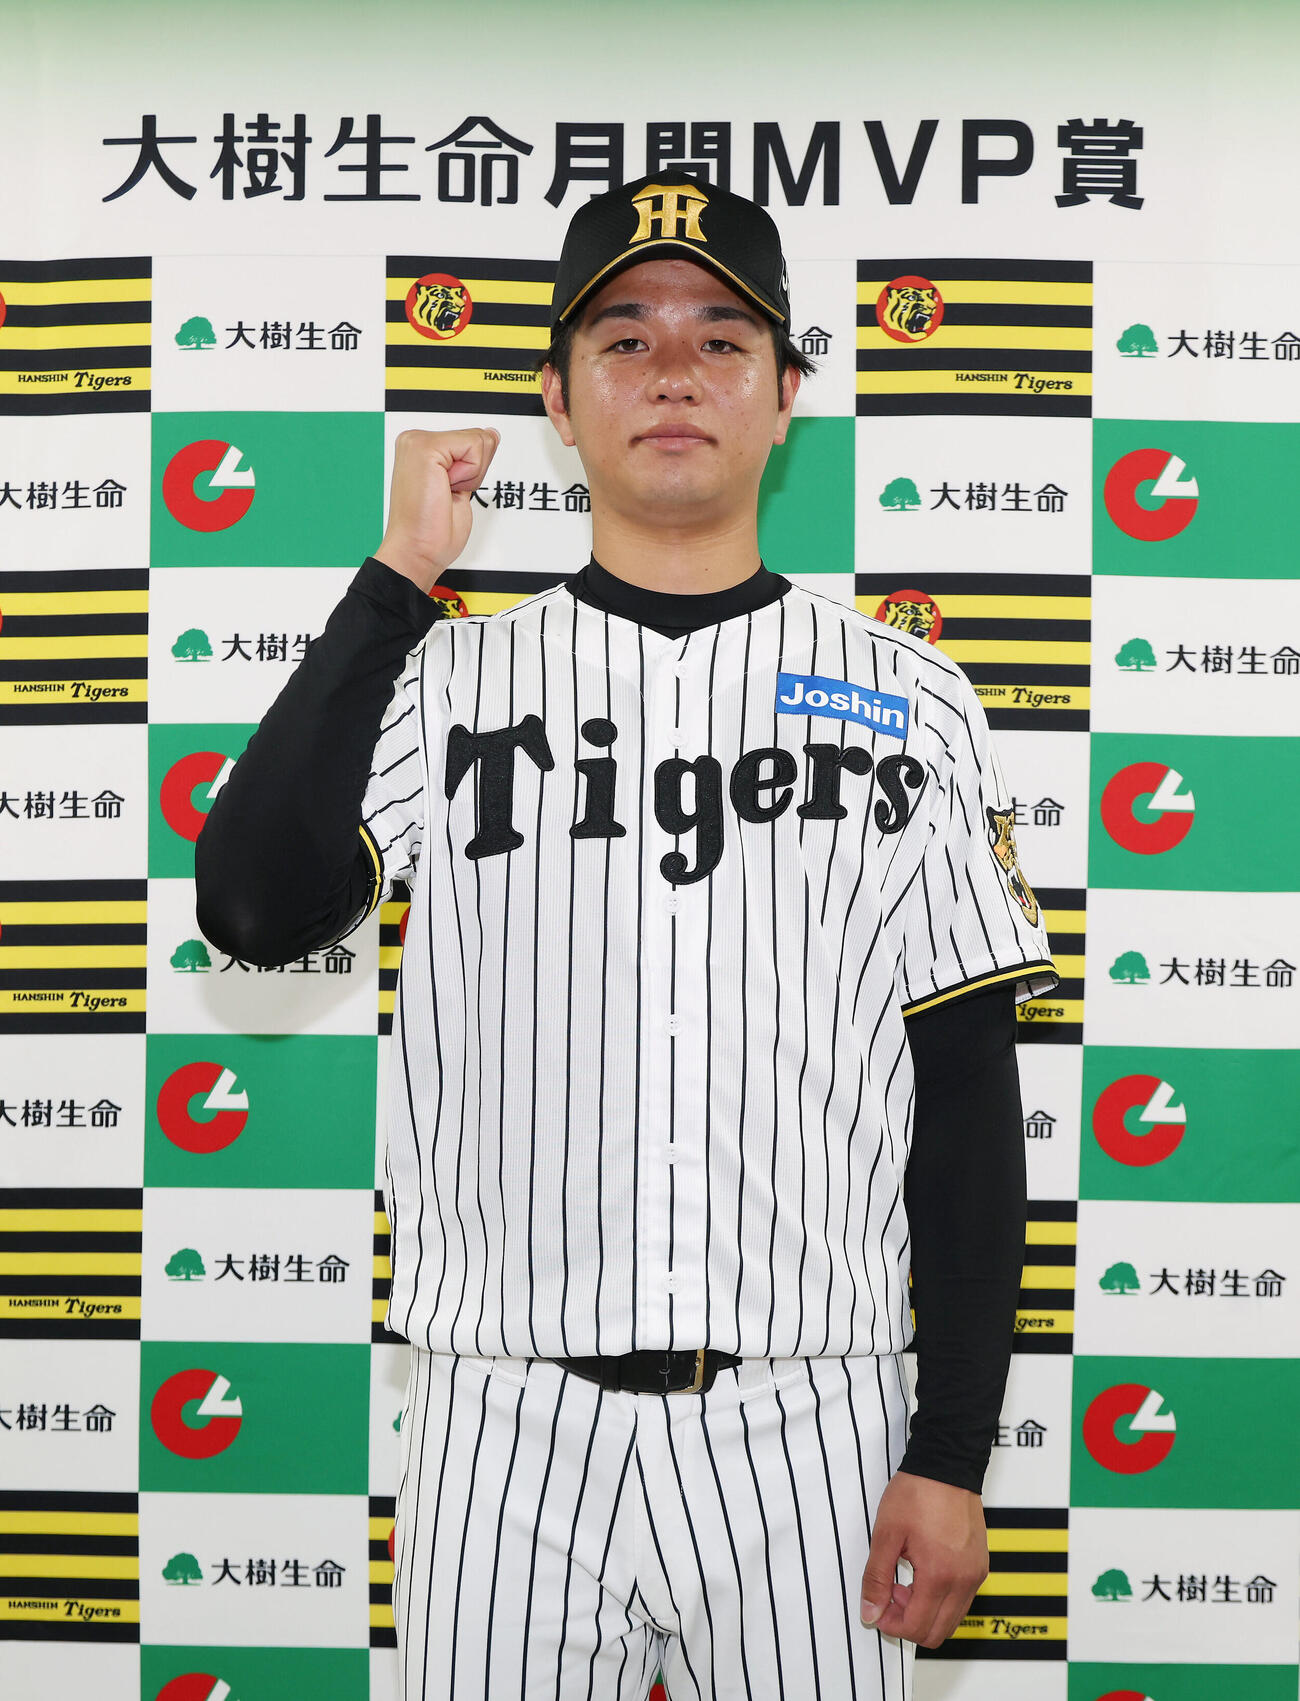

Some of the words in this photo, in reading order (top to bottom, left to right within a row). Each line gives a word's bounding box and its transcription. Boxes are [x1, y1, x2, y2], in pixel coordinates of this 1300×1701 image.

[226, 320, 362, 351] 大樹生命
[1168, 329, 1300, 361] 大樹生命
[18, 374, 68, 382] HANSHIN
[74, 372, 132, 390] Tigers
[484, 372, 536, 382] HANSHIN
[955, 374, 1008, 382] HANSHIN
[1014, 373, 1073, 393] Tigers
[930, 482, 1068, 513] 大樹生命
[221, 633, 310, 662] 大樹生
[1166, 644, 1300, 675] 大樹生命
[14, 684, 65, 692] HANSHIN
[71, 682, 128, 701] Tigers
[780, 682, 905, 729] Joshin
[974, 688, 1006, 696] SHIN
[1012, 687, 1071, 707] Tigers
[445, 714, 924, 885] Tigers
[1159, 957, 1296, 988] 大樹生命
[13, 993, 64, 1001] HANSHIN
[70, 992, 127, 1011] Tigers
[1019, 1004, 1064, 1020] igers
[214, 1254, 349, 1284] 大樹生命
[1150, 1268, 1286, 1298] 大樹生命
[65, 1298, 122, 1318] Tigers
[1014, 1317, 1055, 1332] gers
[211, 1558, 346, 1588] 大樹生命
[1142, 1574, 1277, 1604] 大樹生命
[64, 1600, 121, 1620] Tigers
[991, 1618, 1048, 1639] Tigers
